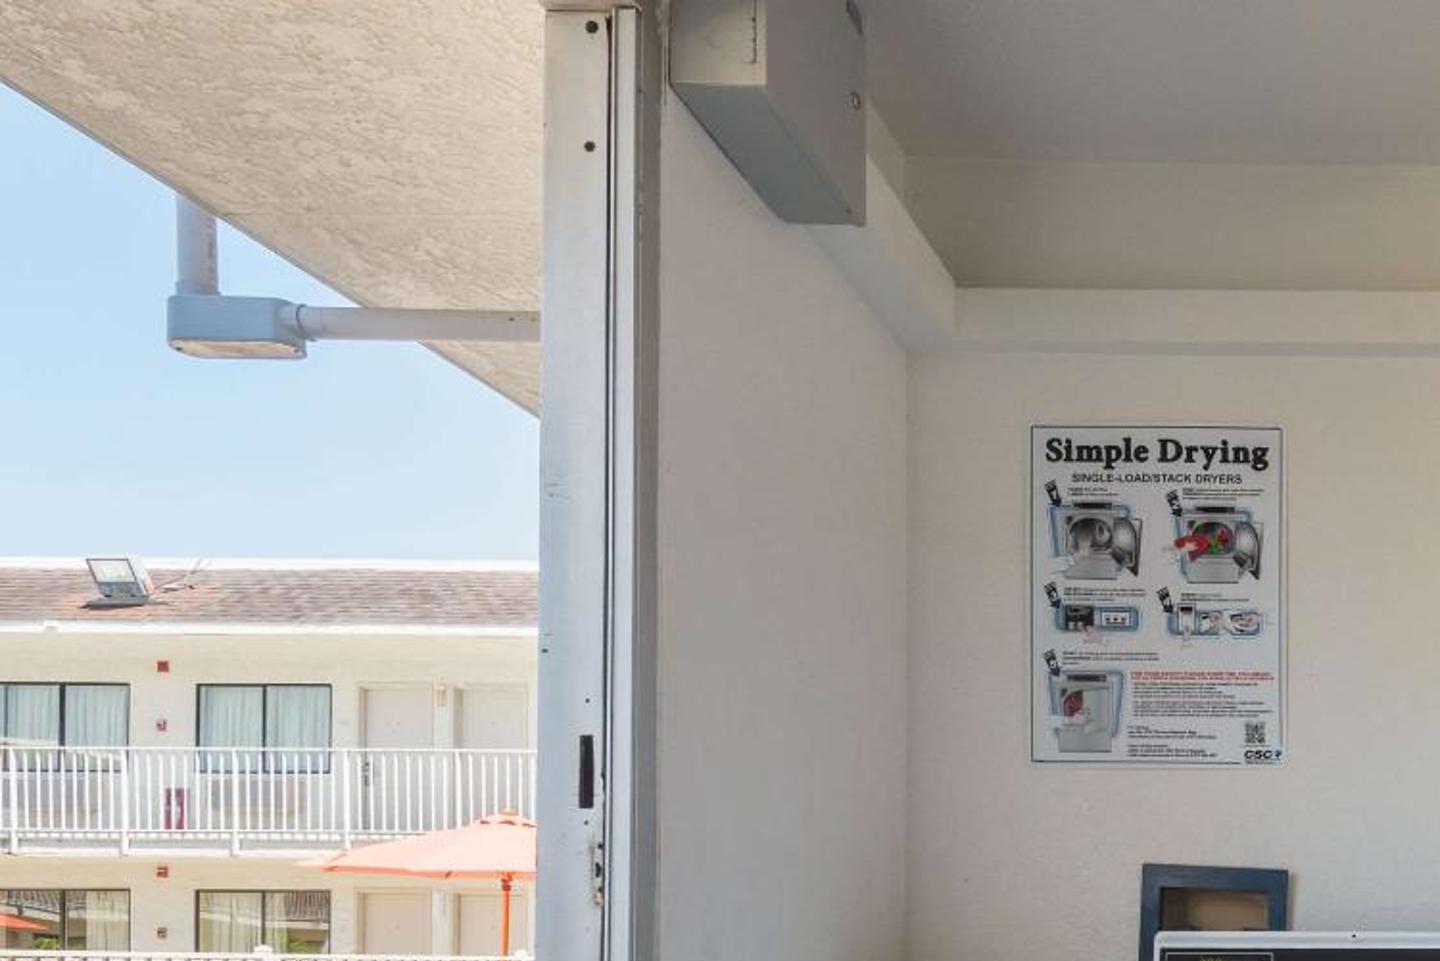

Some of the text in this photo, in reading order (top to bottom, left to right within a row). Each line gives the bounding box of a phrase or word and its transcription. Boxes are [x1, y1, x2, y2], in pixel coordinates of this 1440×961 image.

[1045, 437, 1270, 471] Simple Drying
[1072, 473, 1243, 485] SINGLE-LOAD/STACK DRYERS
